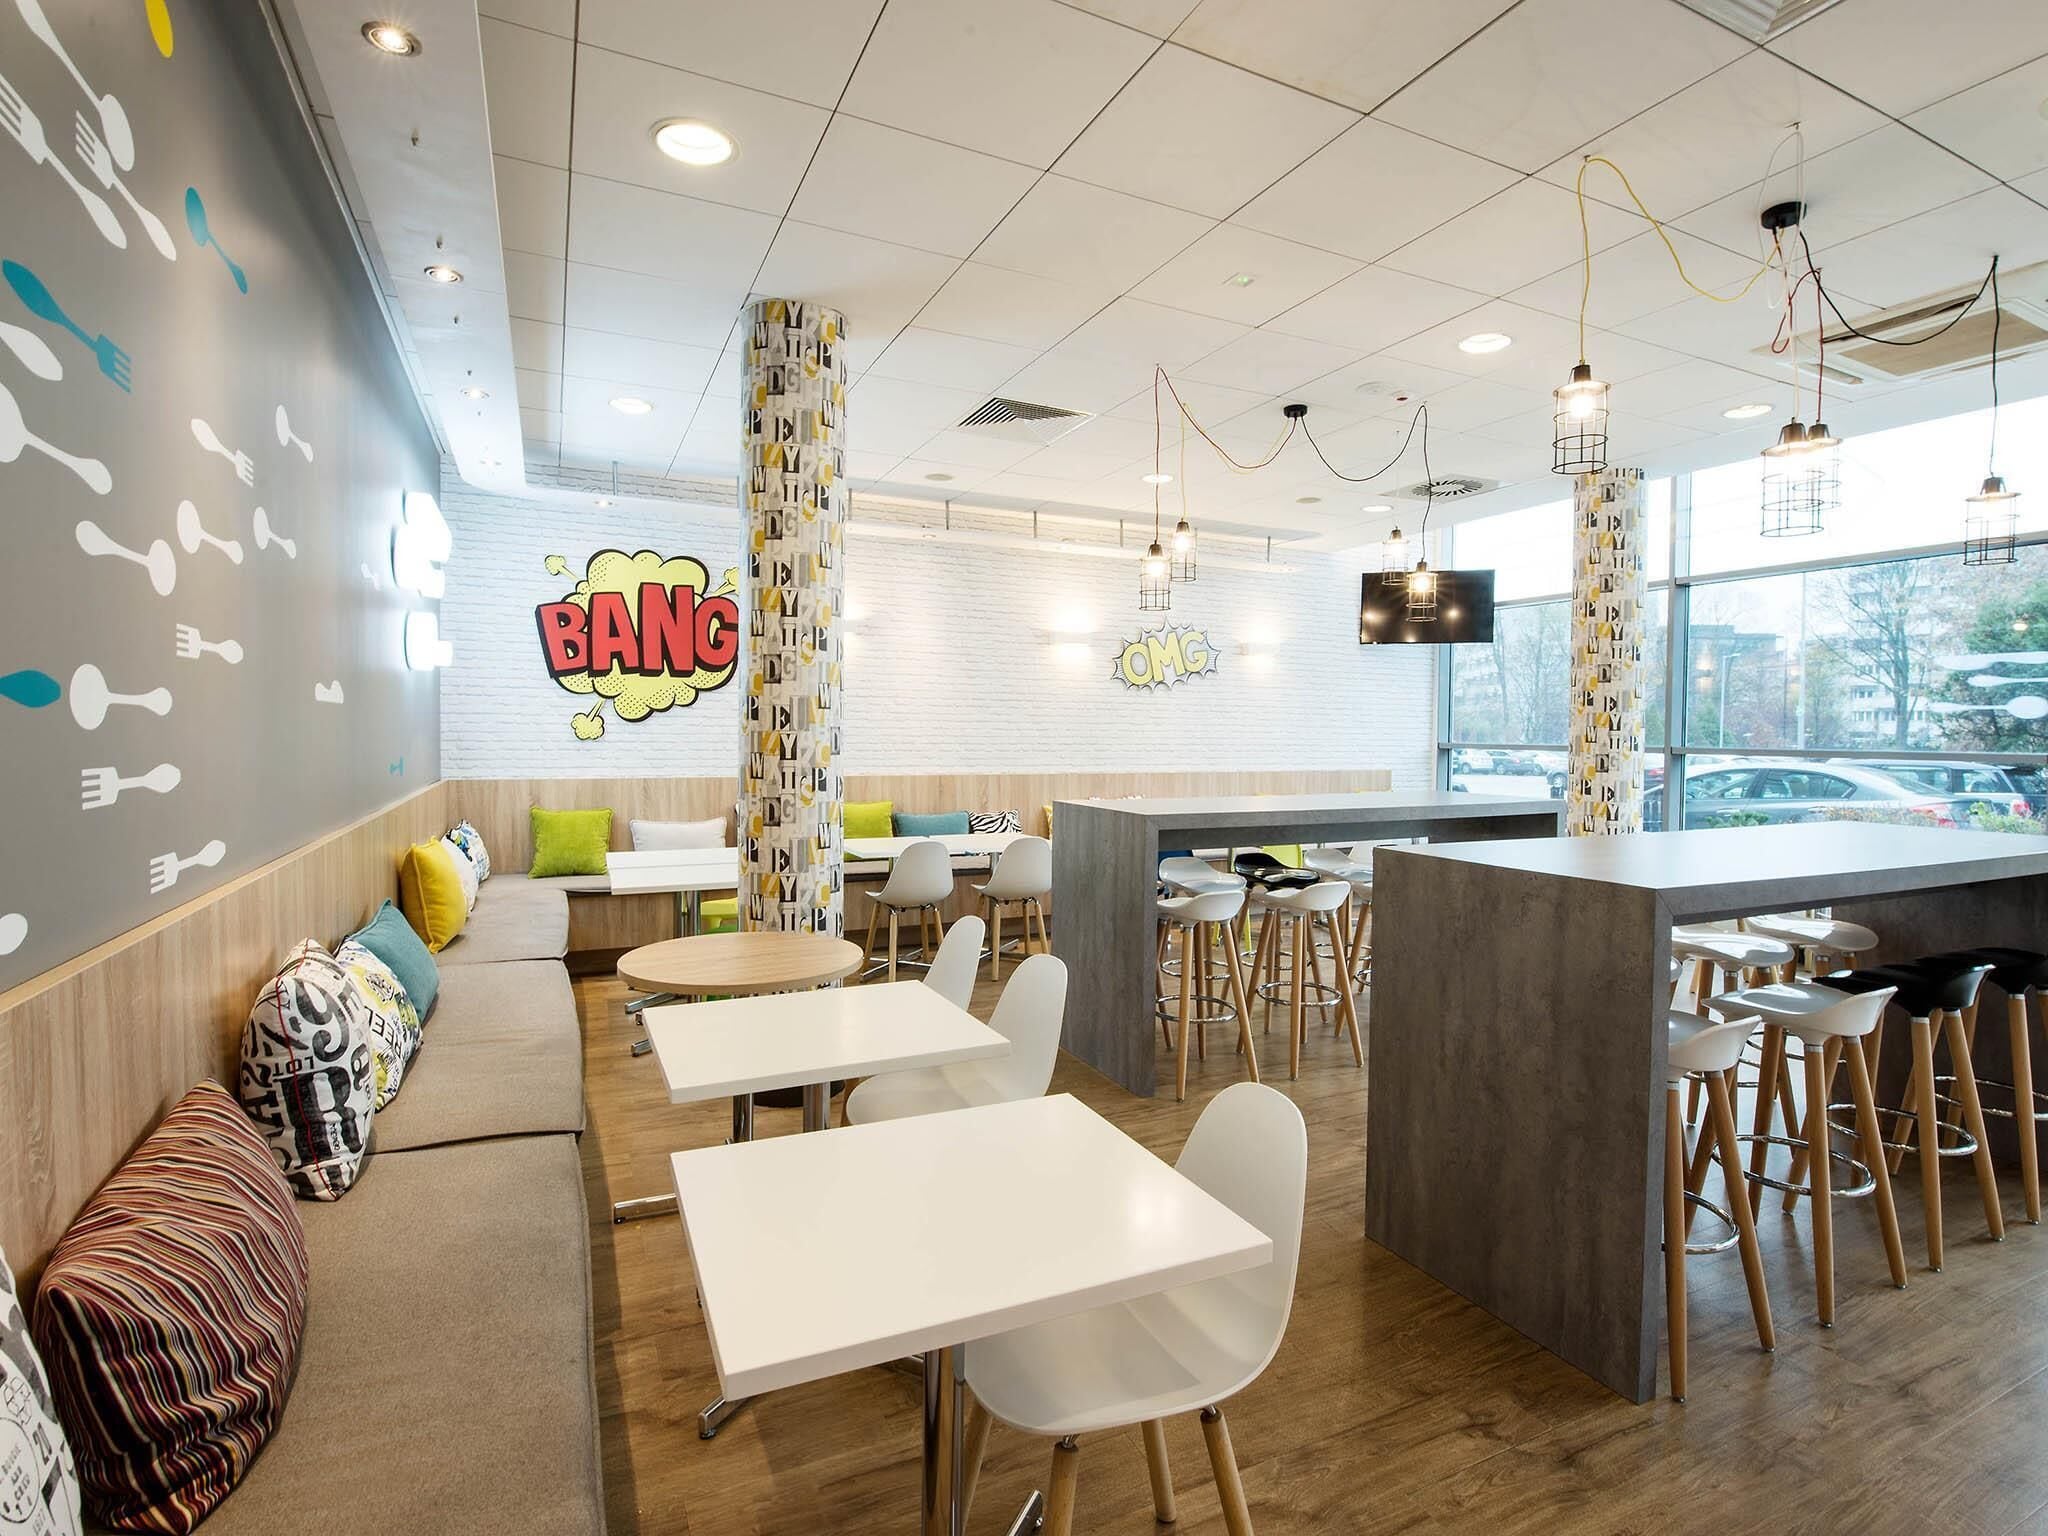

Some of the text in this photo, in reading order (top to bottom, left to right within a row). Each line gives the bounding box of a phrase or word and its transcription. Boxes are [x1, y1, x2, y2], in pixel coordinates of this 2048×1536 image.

[535, 582, 739, 678] BANG
[1122, 631, 1208, 686] OMG
[272, 1056, 313, 1077] LOT
